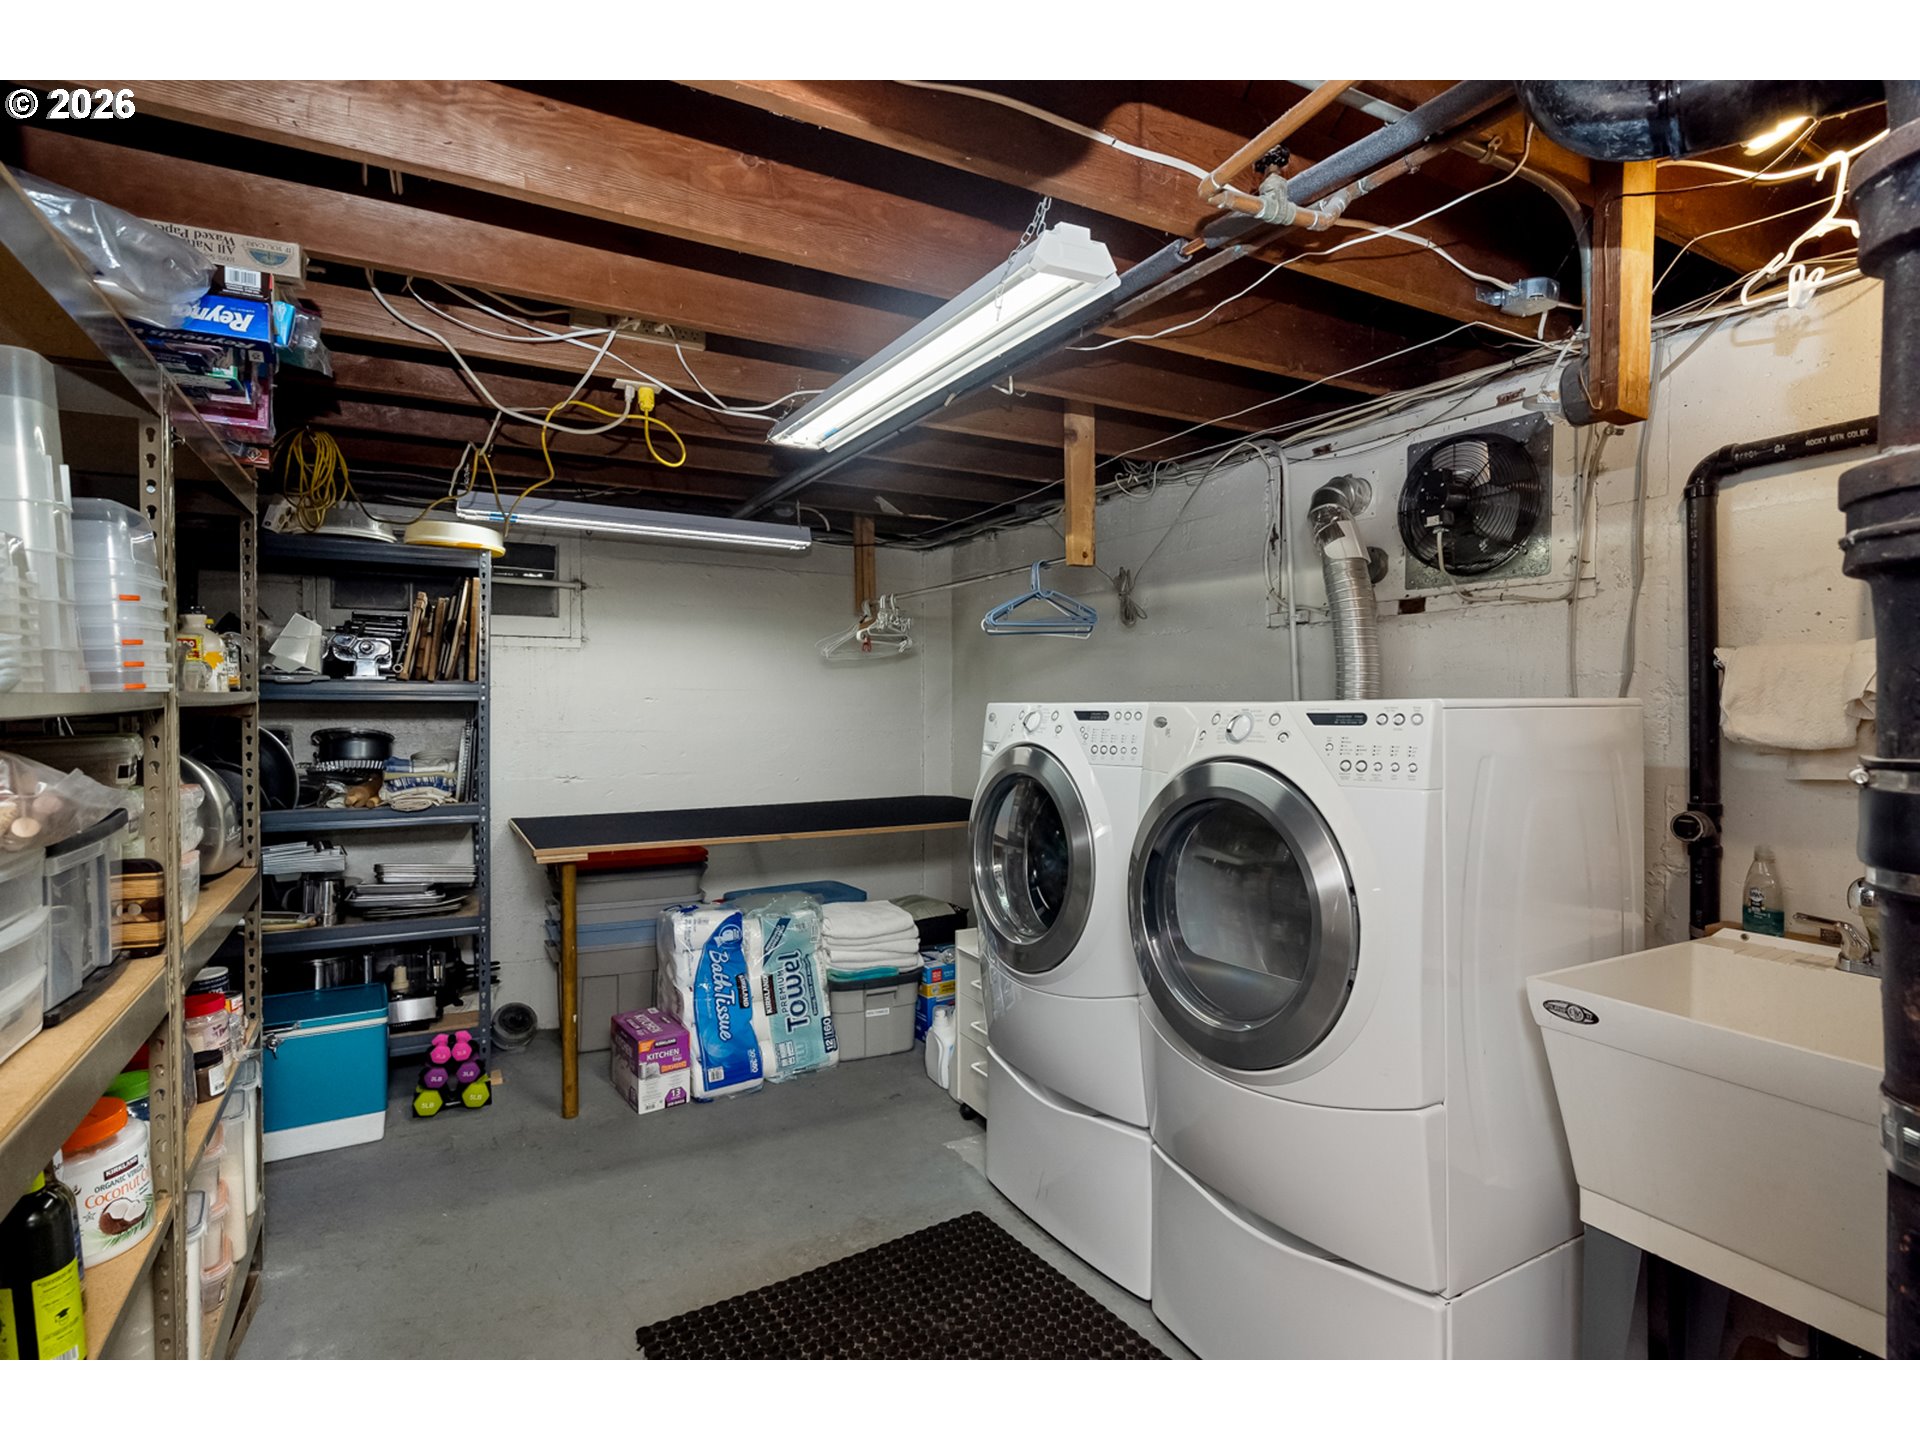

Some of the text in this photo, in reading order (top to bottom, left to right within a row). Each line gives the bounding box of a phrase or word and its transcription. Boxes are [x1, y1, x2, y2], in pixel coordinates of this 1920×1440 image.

[194, 230, 236, 247] Waxed
[217, 244, 236, 255] All
[709, 950, 737, 1043] Bath Tissue
[761, 974, 774, 1015] KIRKLAND
[775, 969, 788, 1014] PREMIUM
[778, 950, 809, 1034] Towel
[646, 1048, 681, 1061] KITCHEN
[671, 1088, 681, 1097] 13
[94, 1174, 126, 1194] ORGANIC
[127, 1163, 144, 1178] VIRGIN
[105, 1156, 138, 1177] KIRKLAND
[84, 1175, 140, 1210] Coconut
